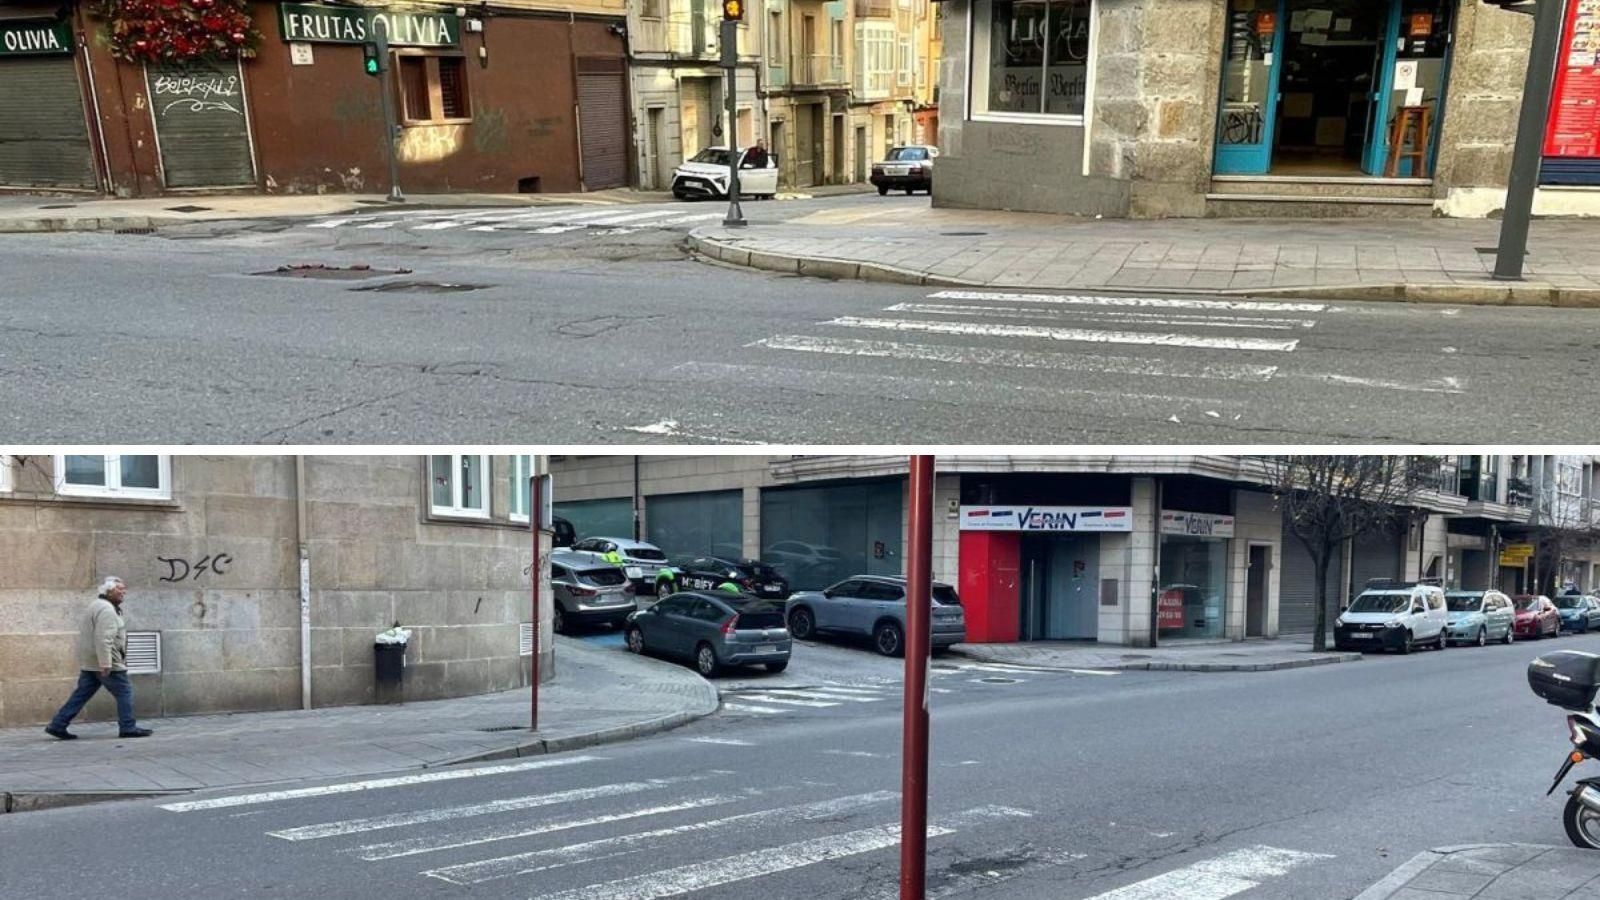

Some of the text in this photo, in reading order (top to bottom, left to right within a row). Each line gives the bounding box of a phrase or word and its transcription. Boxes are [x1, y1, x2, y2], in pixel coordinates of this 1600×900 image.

[5, 28, 60, 51] OLIVIA
[289, 13, 452, 43] FRUTAS OLIVIA
[1018, 507, 1077, 530] VERIN
